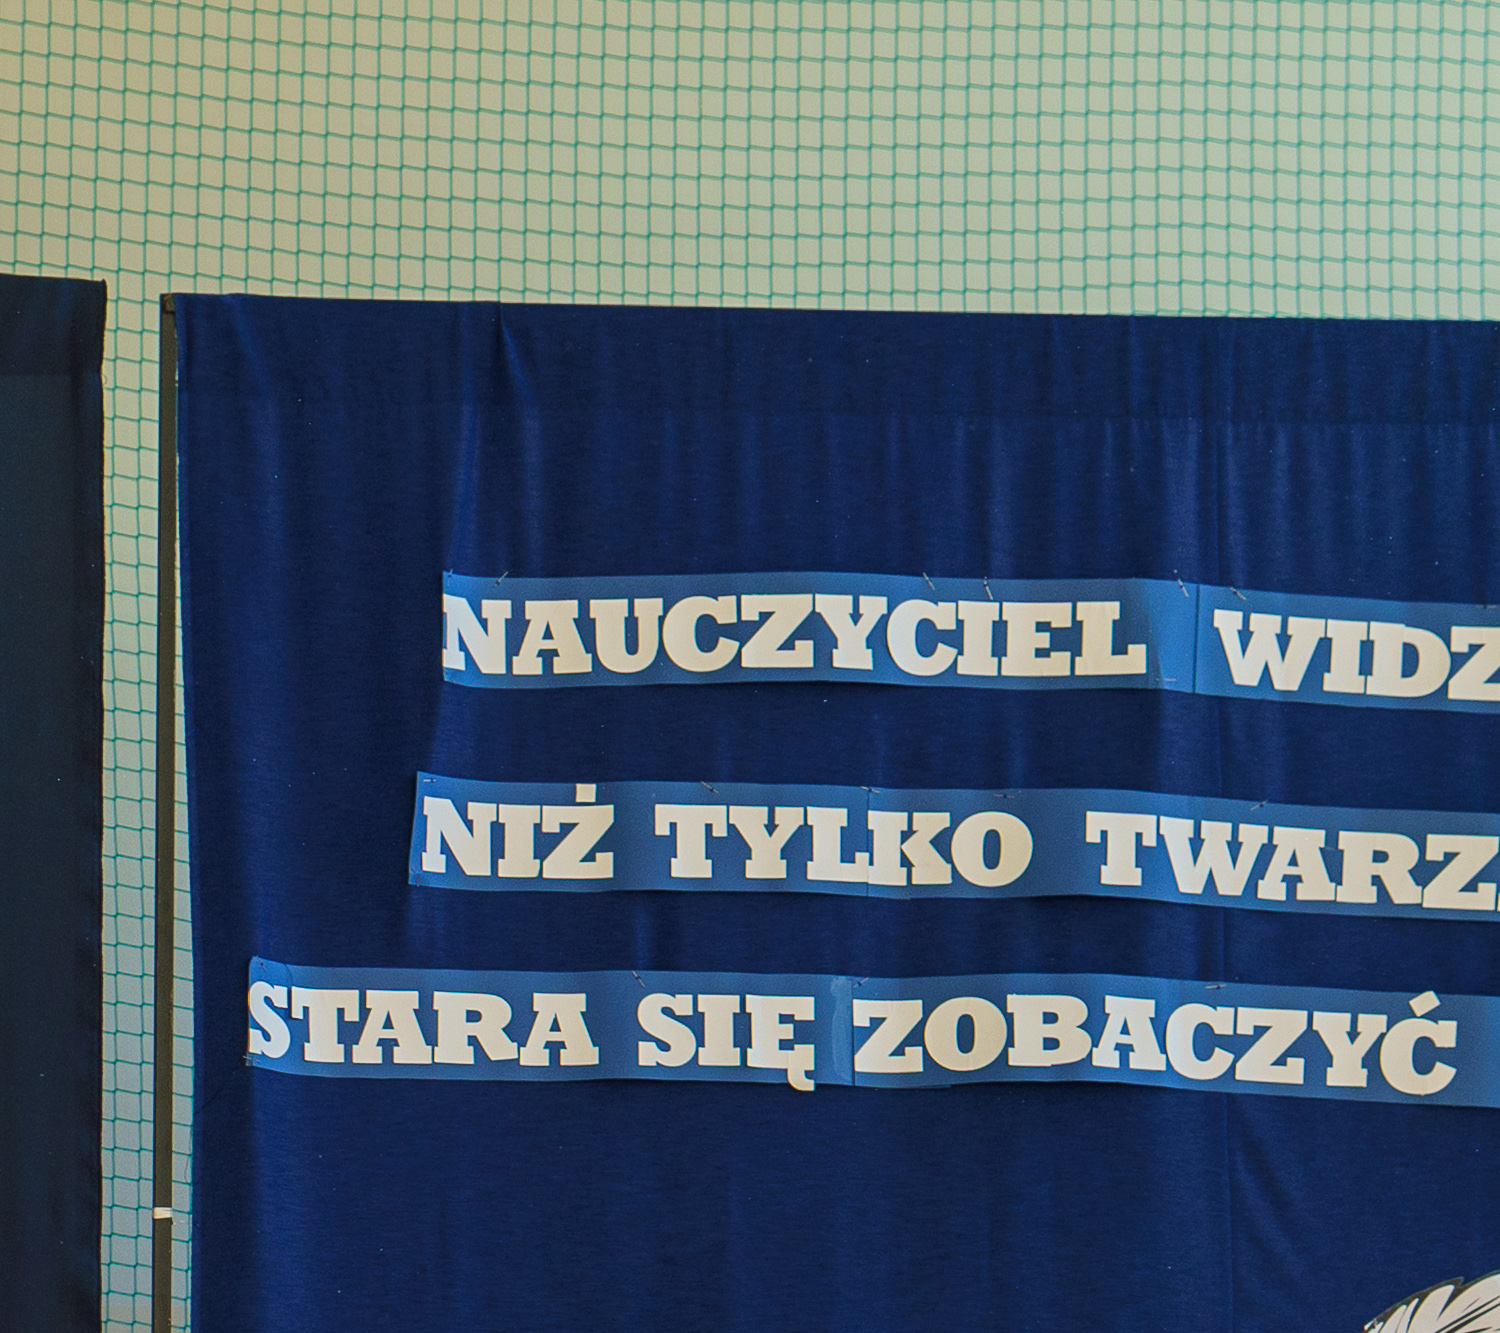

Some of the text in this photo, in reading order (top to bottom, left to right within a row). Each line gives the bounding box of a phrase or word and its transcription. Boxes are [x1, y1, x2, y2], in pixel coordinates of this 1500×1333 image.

[442, 592, 1147, 678] NAUCZYCIEL
[421, 783, 614, 880] NIŻ
[655, 803, 1034, 889] TYLKO
[247, 981, 599, 1067] STARA
[638, 993, 816, 1091] SIĘ
[852, 991, 1458, 1097] ZOBACZYĆ
